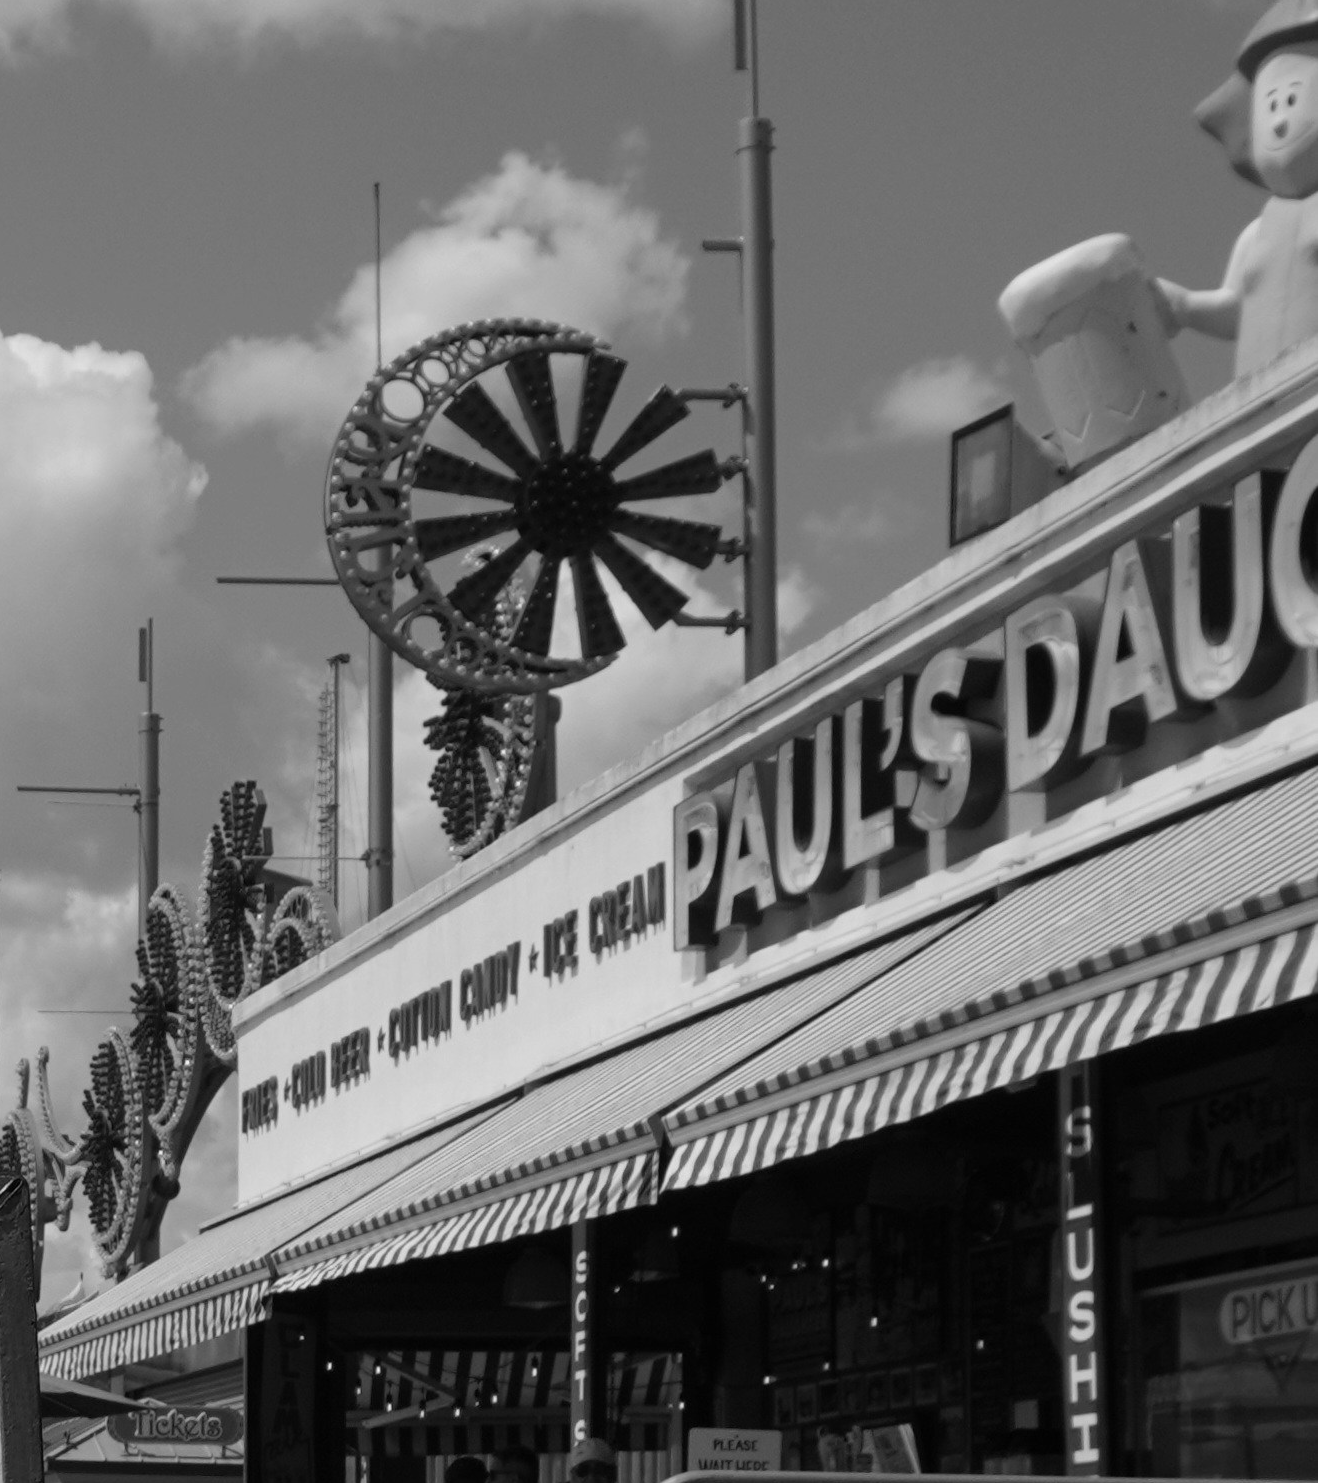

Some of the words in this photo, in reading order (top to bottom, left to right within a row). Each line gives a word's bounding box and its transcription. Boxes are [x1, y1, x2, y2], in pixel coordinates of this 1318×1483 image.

[674, 648, 973, 951] PAUL'S
[291, 1050, 327, 1111] COLD
[330, 1027, 371, 1092] BEER
[388, 980, 453, 1062] COTTON
[459, 940, 522, 1023] CANDY
[543, 908, 579, 984] ICE
[589, 861, 667, 963] CREAM
[1231, 1283, 1300, 1335] PICK
[128, 1409, 223, 1440] Tickets
[712, 1438, 759, 1452] PLEASE
